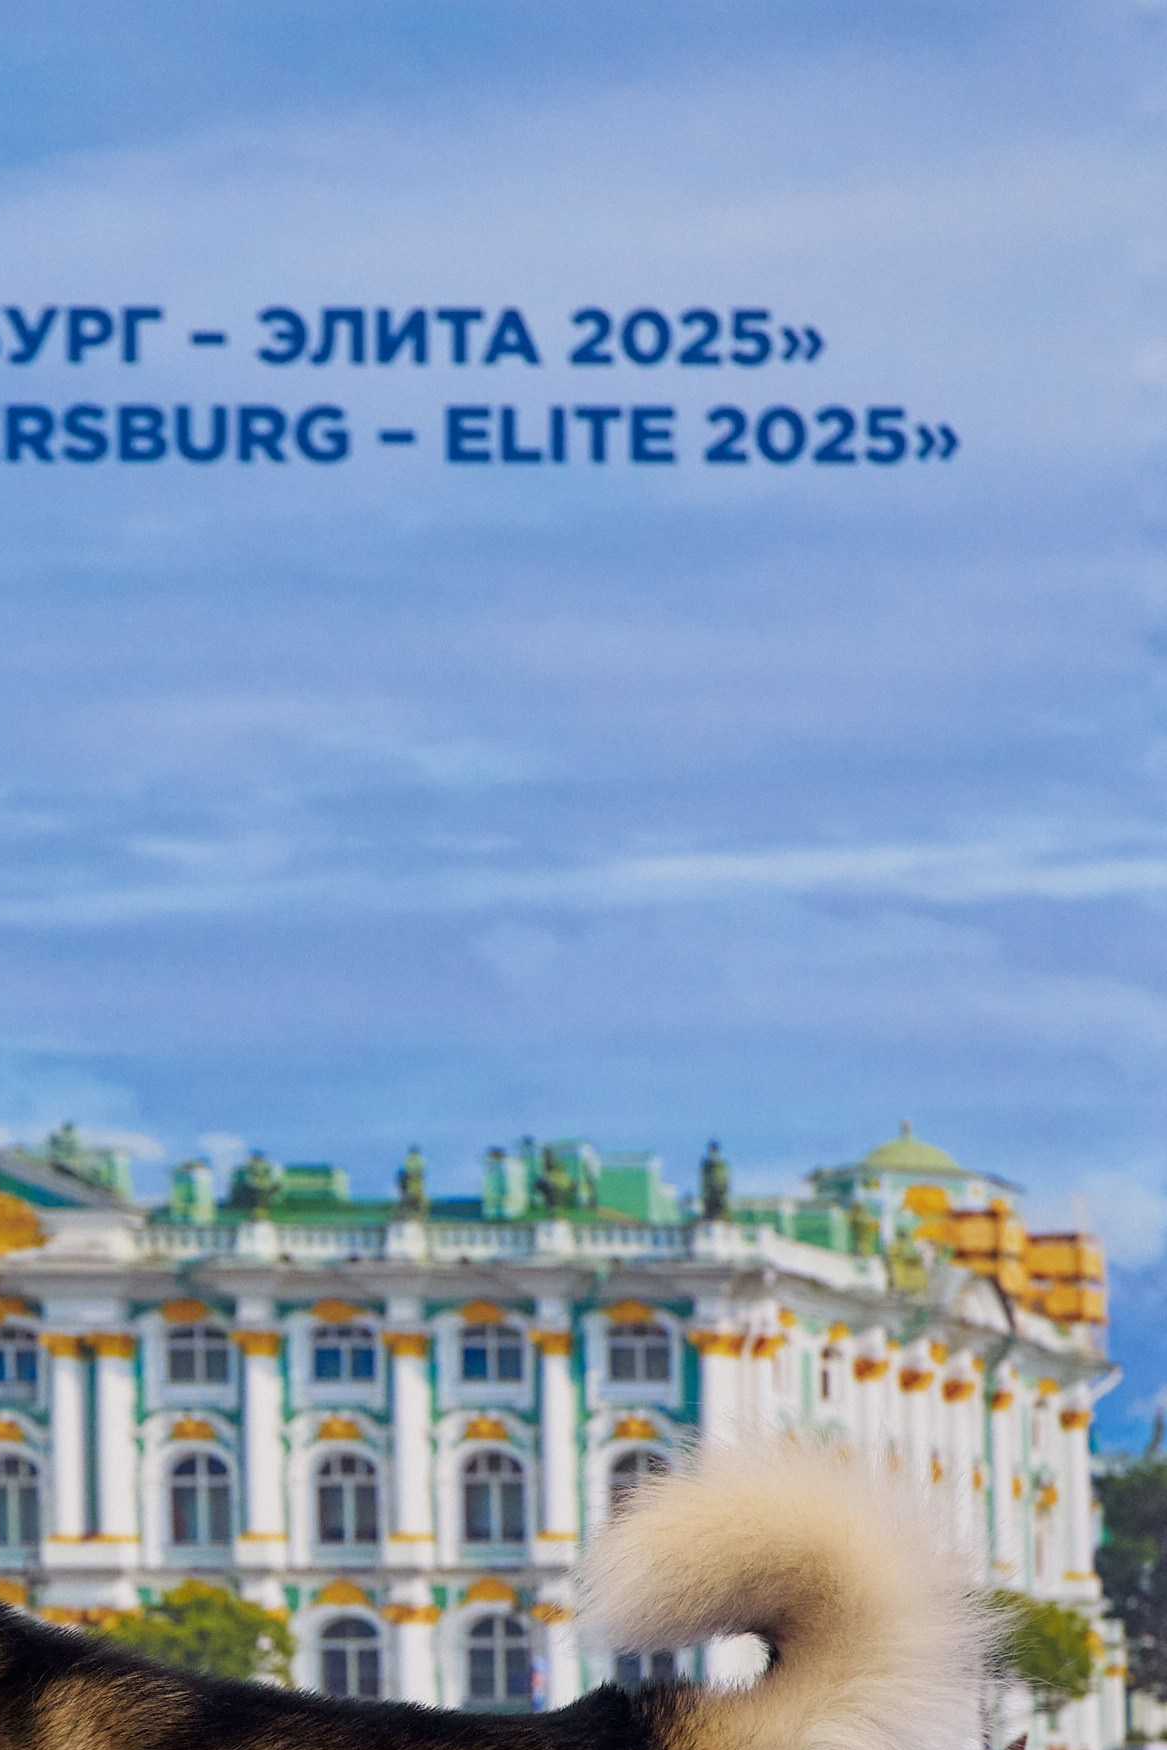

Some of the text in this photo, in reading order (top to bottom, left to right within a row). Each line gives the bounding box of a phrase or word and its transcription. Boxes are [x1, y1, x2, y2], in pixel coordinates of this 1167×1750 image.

[258, 307, 541, 367] ЭЛИТА
[570, 308, 824, 368] 2025»
[445, 405, 676, 466] ELITE
[704, 406, 960, 466] 2025»
